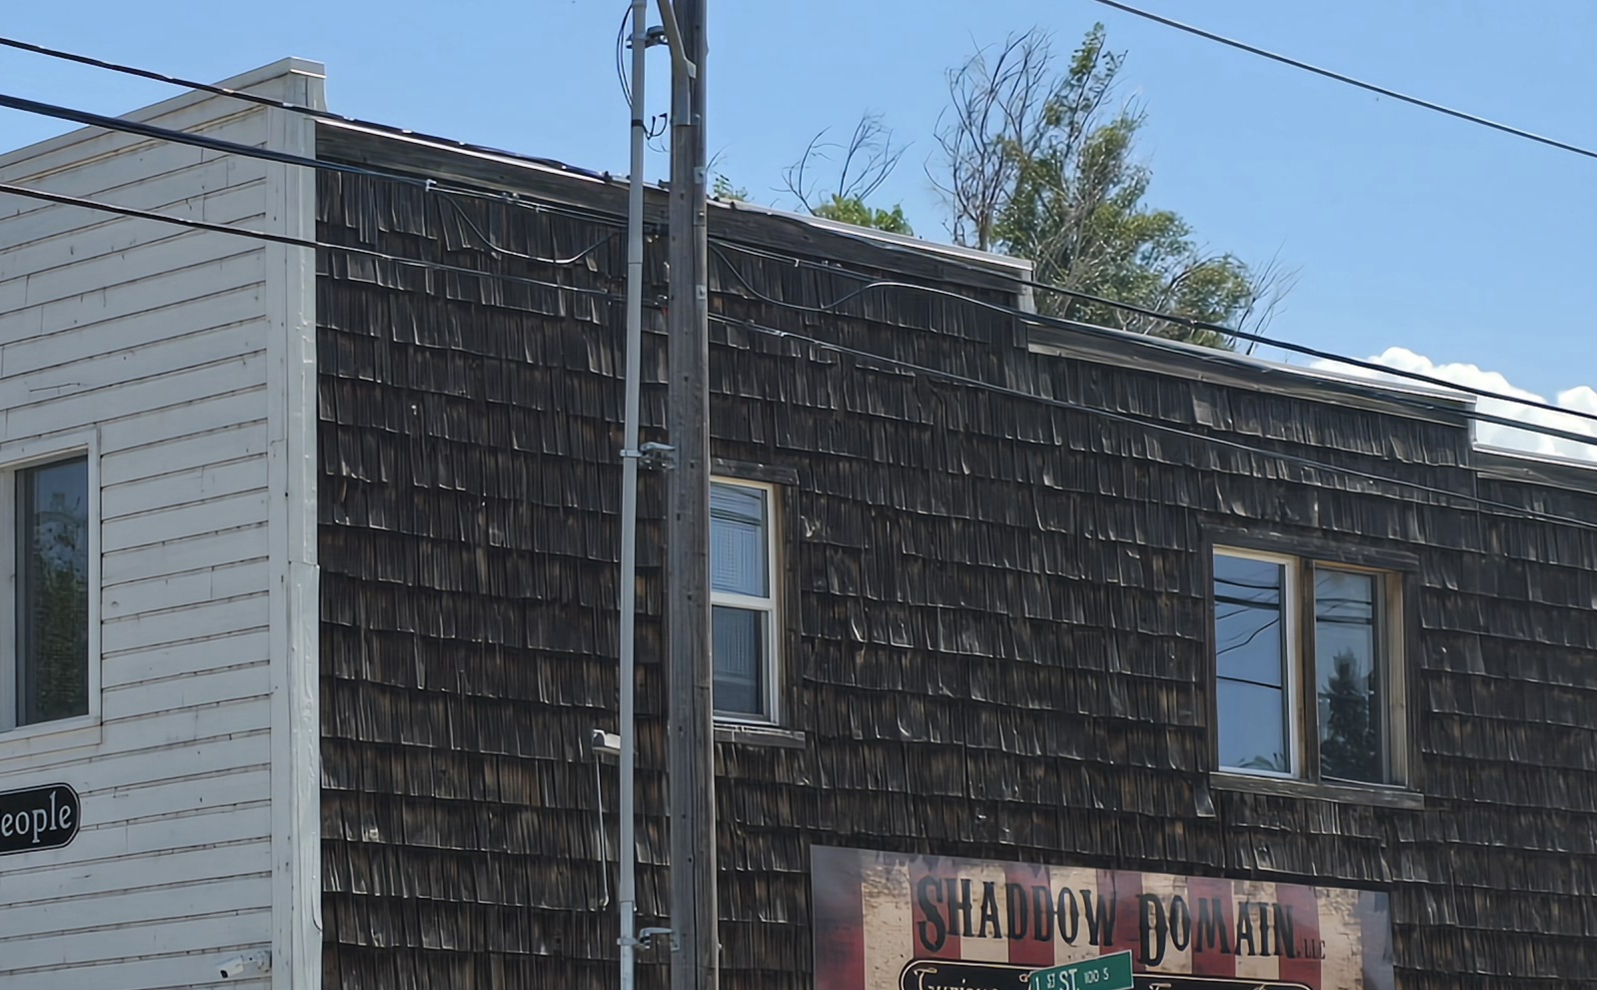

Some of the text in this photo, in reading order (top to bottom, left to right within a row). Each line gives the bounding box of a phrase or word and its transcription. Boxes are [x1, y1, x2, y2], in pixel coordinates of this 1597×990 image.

[916, 874, 1117, 952] SHADDOW
[1303, 938, 1326, 960] LLC
[1103, 967, 1110, 981] S
